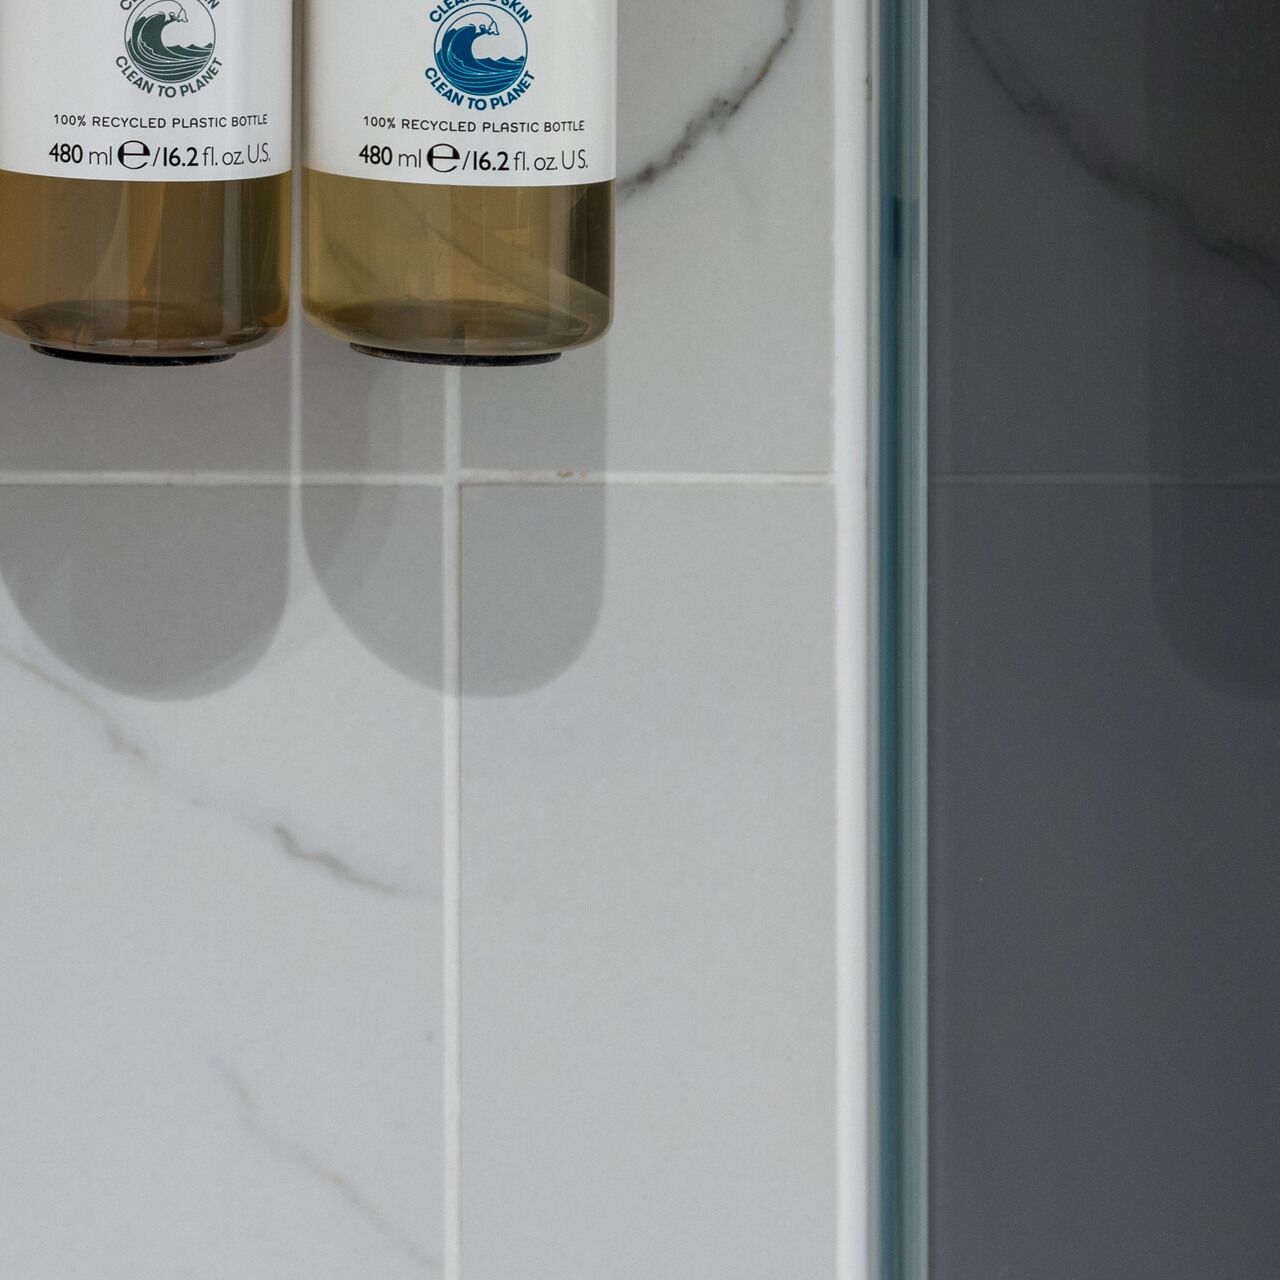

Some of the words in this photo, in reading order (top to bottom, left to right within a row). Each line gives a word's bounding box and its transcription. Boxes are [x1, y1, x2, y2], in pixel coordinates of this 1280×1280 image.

[116, 56, 155, 95] CLEAN
[158, 86, 177, 99] TO
[180, 58, 223, 97] PLANET
[425, 68, 465, 106] CLEAN
[468, 98, 487, 111] TO
[490, 71, 536, 110] PLANET
[53, 113, 87, 128] 100%
[92, 115, 167, 129] RECYCLED
[172, 116, 227, 129] PLASTIC
[231, 113, 268, 128] BOTTLE
[363, 115, 396, 130] 100%
[401, 118, 477, 133] RECYCLED
[482, 121, 540, 133] PLASTIC
[543, 119, 585, 133] BOTTLE
[48, 142, 84, 164] 480
[358, 144, 393, 166] 480
